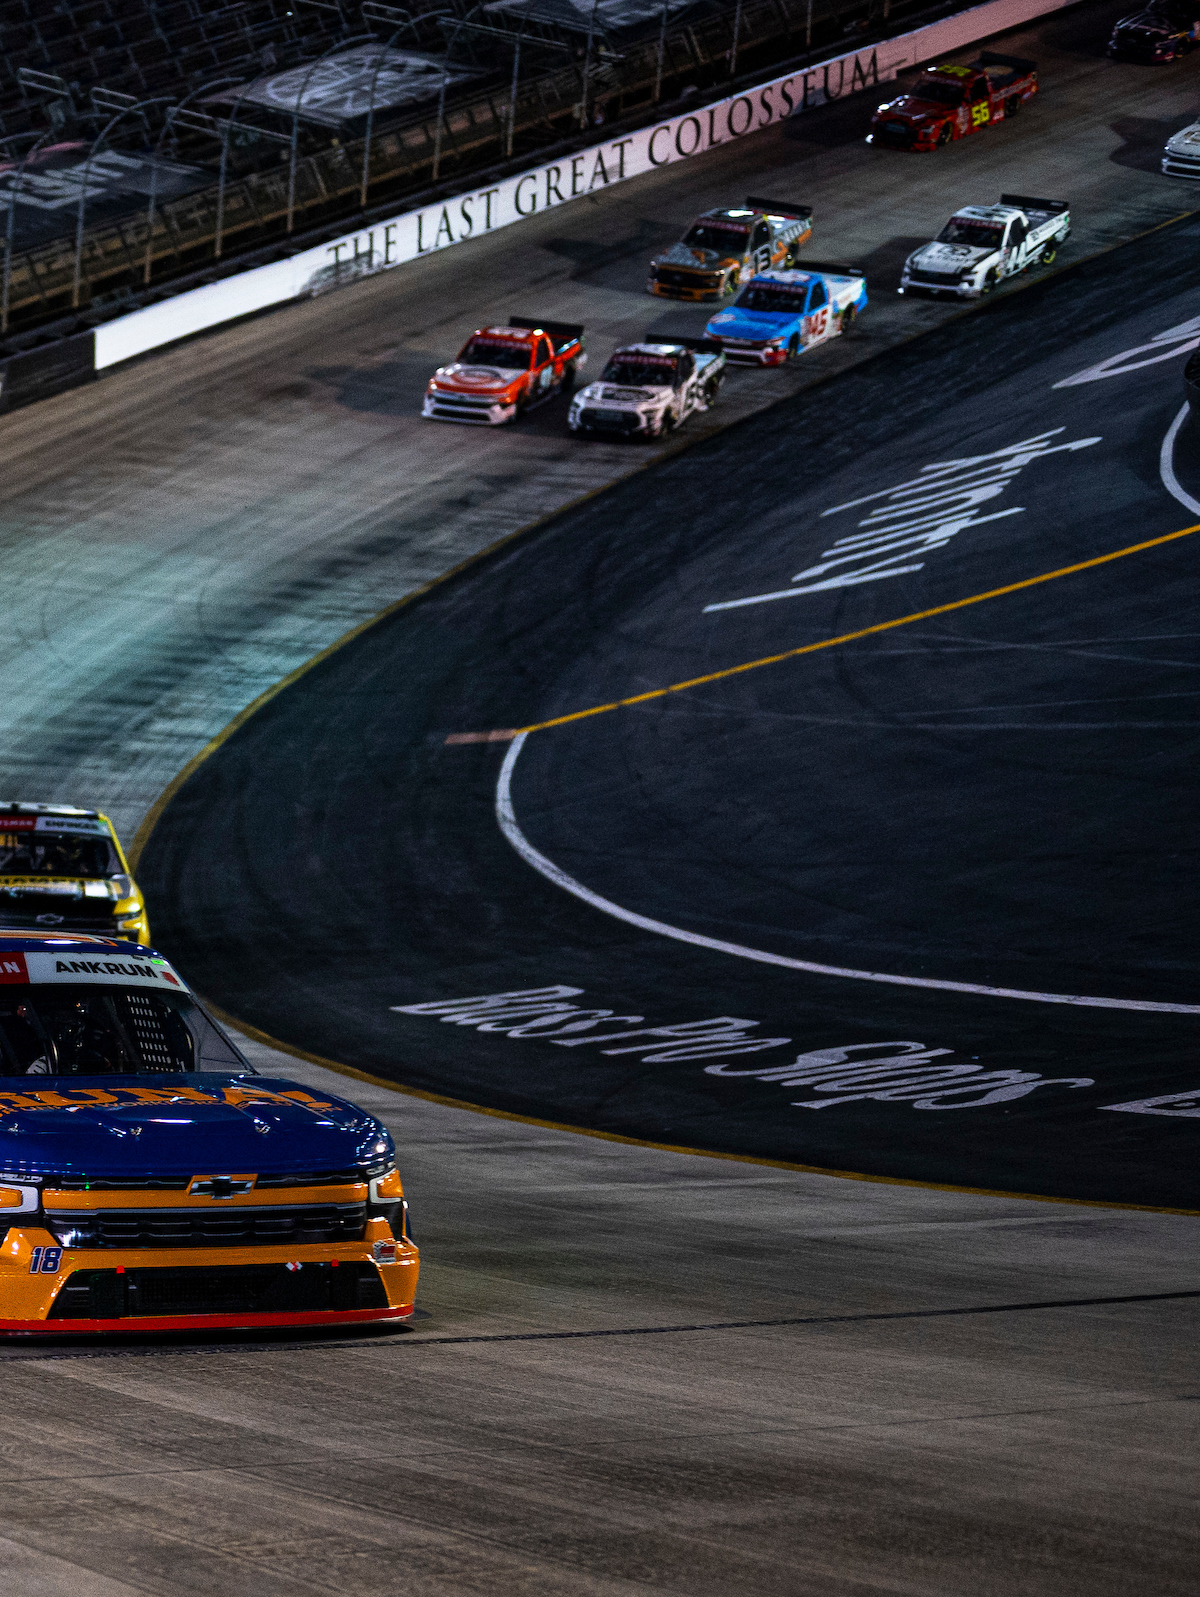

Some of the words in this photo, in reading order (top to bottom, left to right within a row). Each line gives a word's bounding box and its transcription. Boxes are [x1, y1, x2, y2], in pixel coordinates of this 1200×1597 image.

[971, 101, 990, 127] 56
[327, 224, 397, 282] THE
[417, 189, 499, 252] LAST
[515, 139, 633, 216] GREAT
[648, 47, 879, 165] COLOSSEUM
[753, 246, 771, 274] 13
[55, 960, 159, 978] ANKRUM
[389, 984, 645, 1038] Bass
[550, 1016, 793, 1064] Pro
[704, 1040, 1096, 1110] Shops
[29, 1246, 64, 1274] 18
